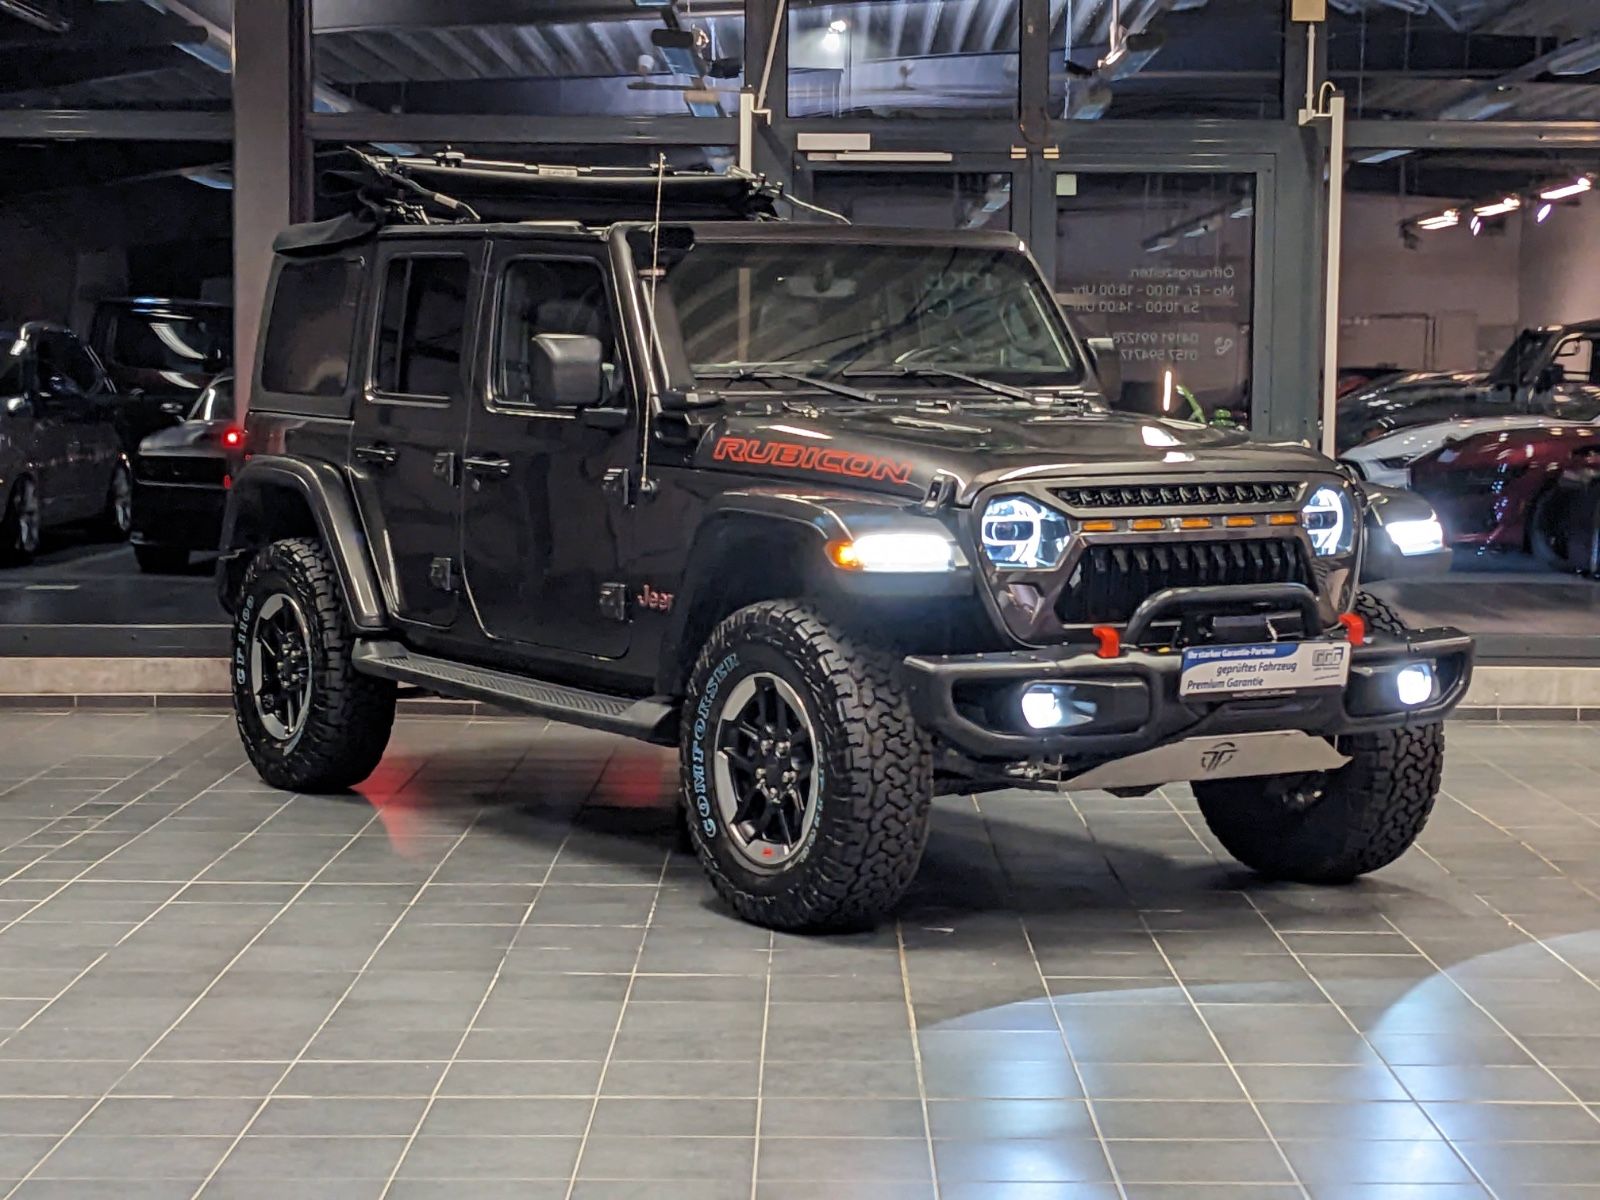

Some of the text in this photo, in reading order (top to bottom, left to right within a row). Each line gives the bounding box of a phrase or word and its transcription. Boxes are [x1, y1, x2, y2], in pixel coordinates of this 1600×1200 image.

[713, 437, 912, 484] RUBICON
[1187, 676, 1264, 690] Premium Garantie
[1217, 661, 1297, 677] geprüftes Fahrzeug
[692, 652, 741, 838] COMFORSER
